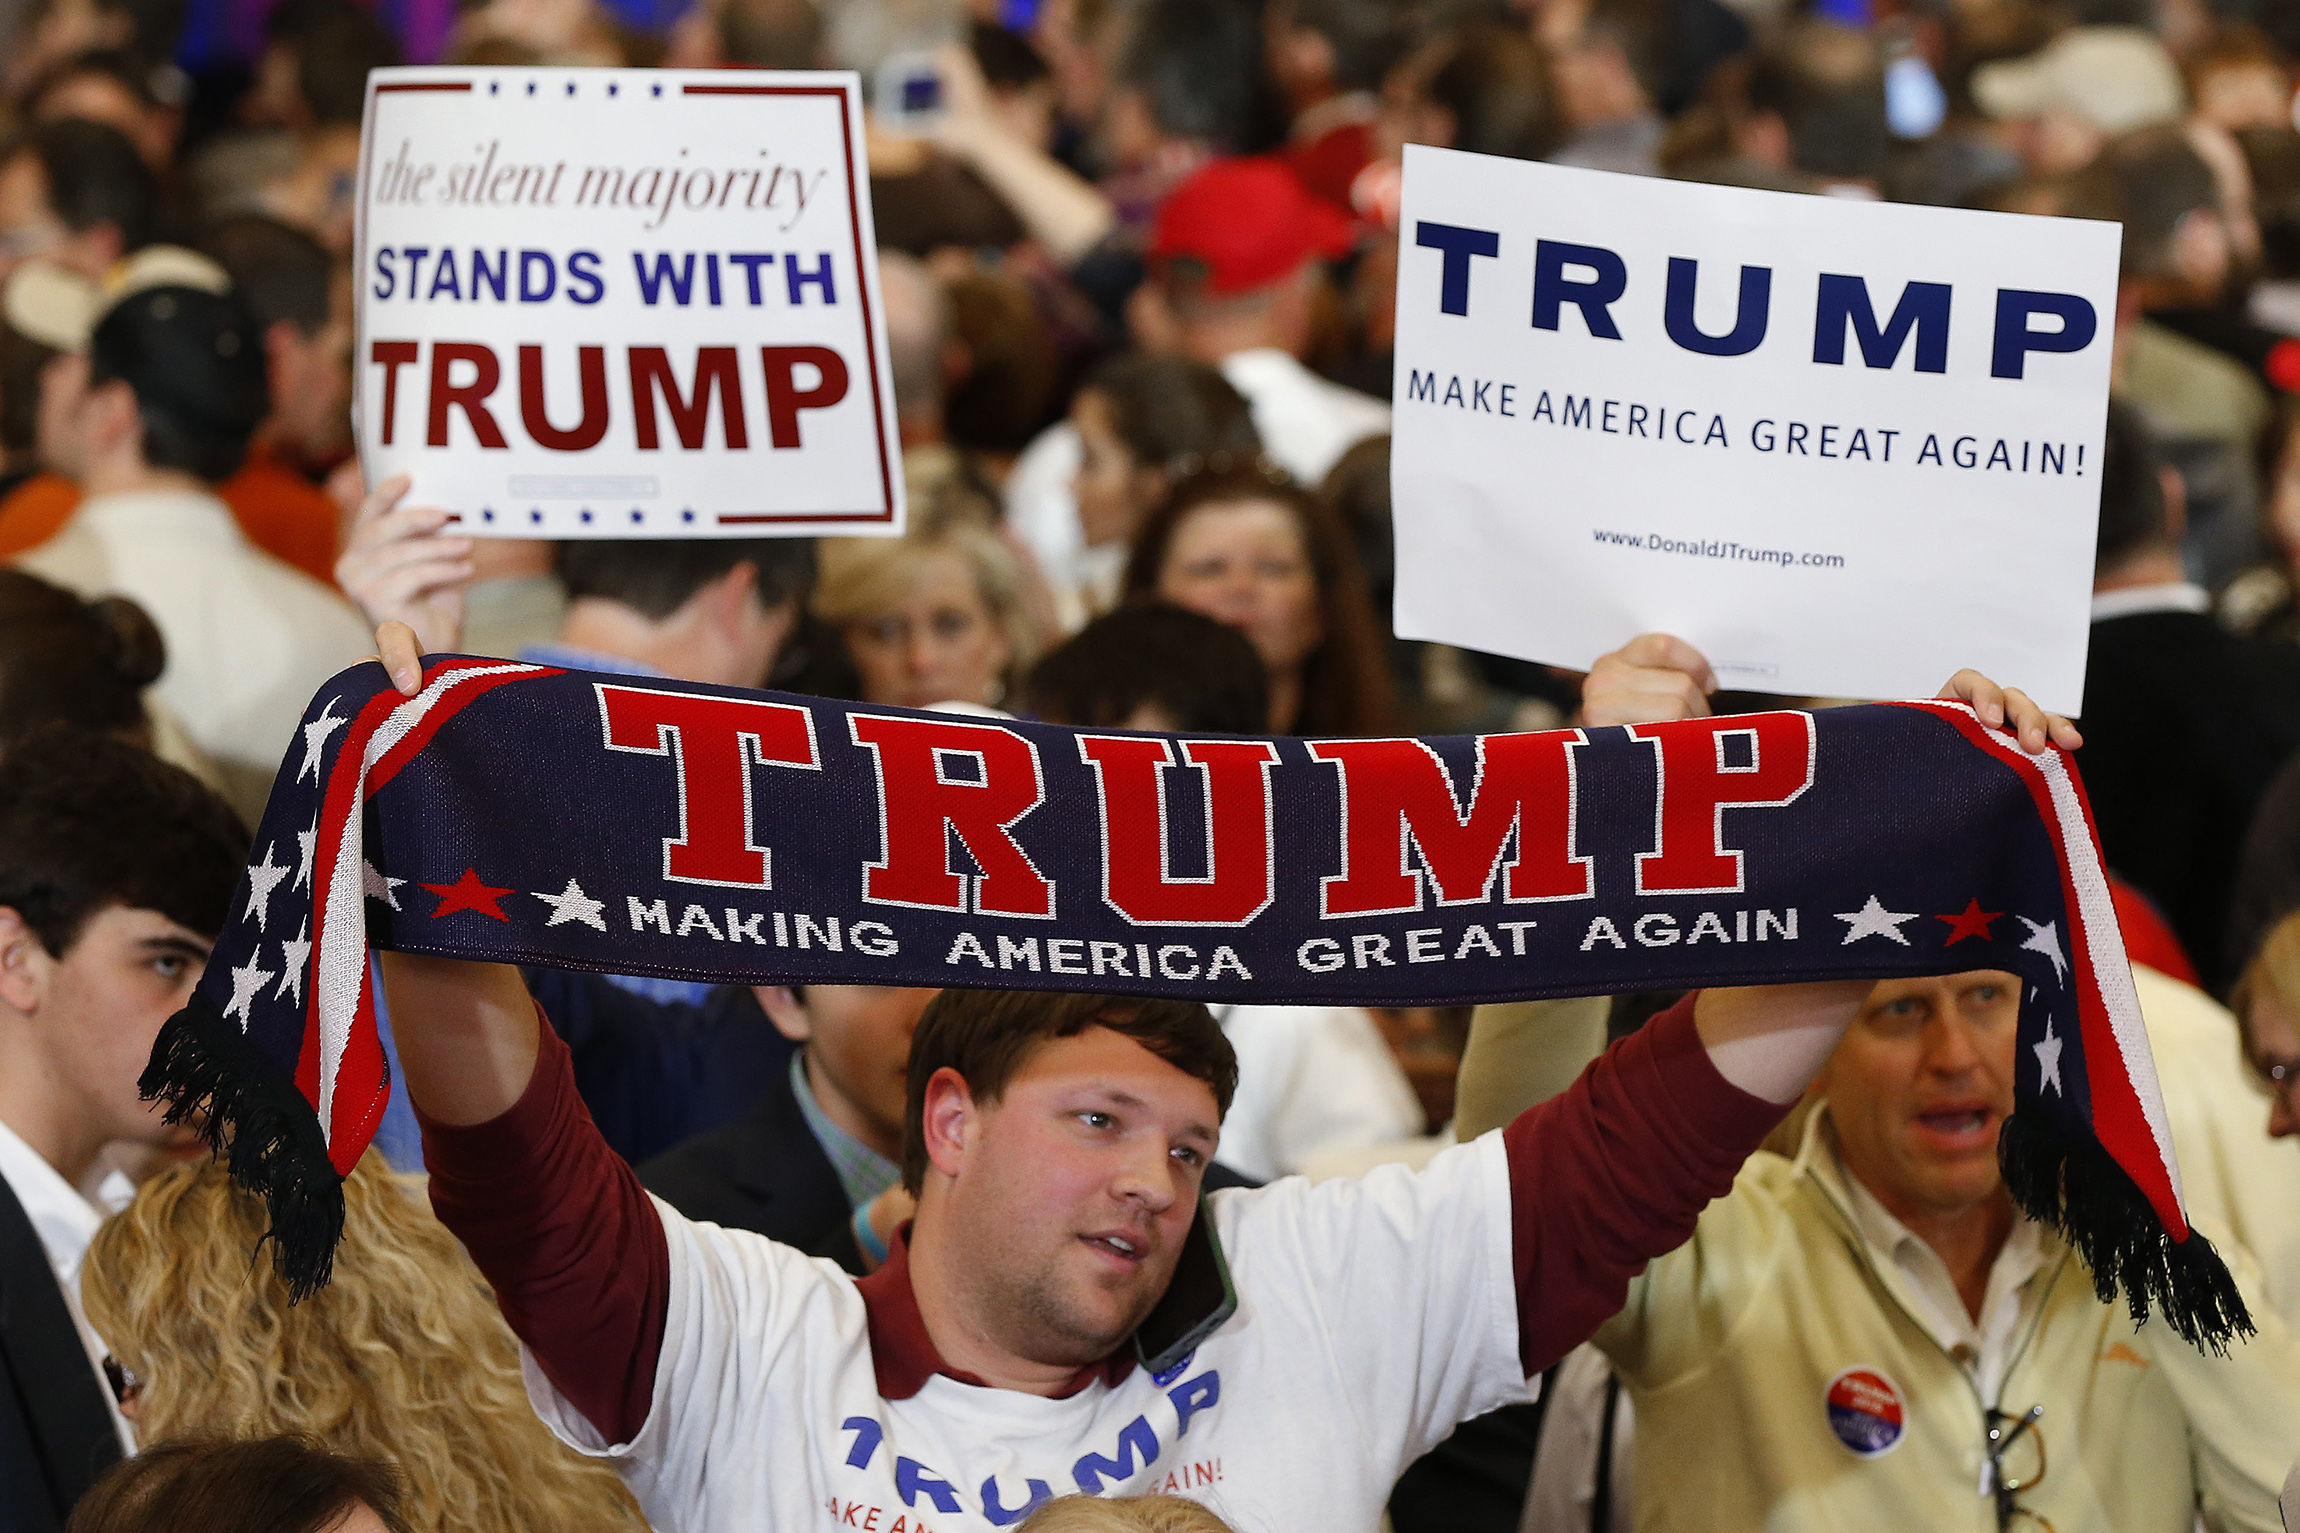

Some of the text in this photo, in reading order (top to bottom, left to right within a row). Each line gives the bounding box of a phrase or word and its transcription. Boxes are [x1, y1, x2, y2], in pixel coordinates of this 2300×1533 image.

[376, 138, 828, 232] the silent majority
[374, 246, 839, 307] STANDS WITH
[1415, 220, 2099, 381] TRUMP
[370, 339, 850, 453] TRUMP
[1408, 369, 2087, 477] MAKE AMERICA GREAT AGAIN!
[1593, 528, 1846, 568] www.DonaldJTrump.com
[592, 682, 1818, 928] TRUMP
[627, 895, 1800, 982] MAKING AMERICA GREAT AGAIN
[825, 1497, 882, 1532] AKE
[1146, 1457, 1224, 1495] GAIN!
[841, 1369, 1221, 1526] TRUMP
